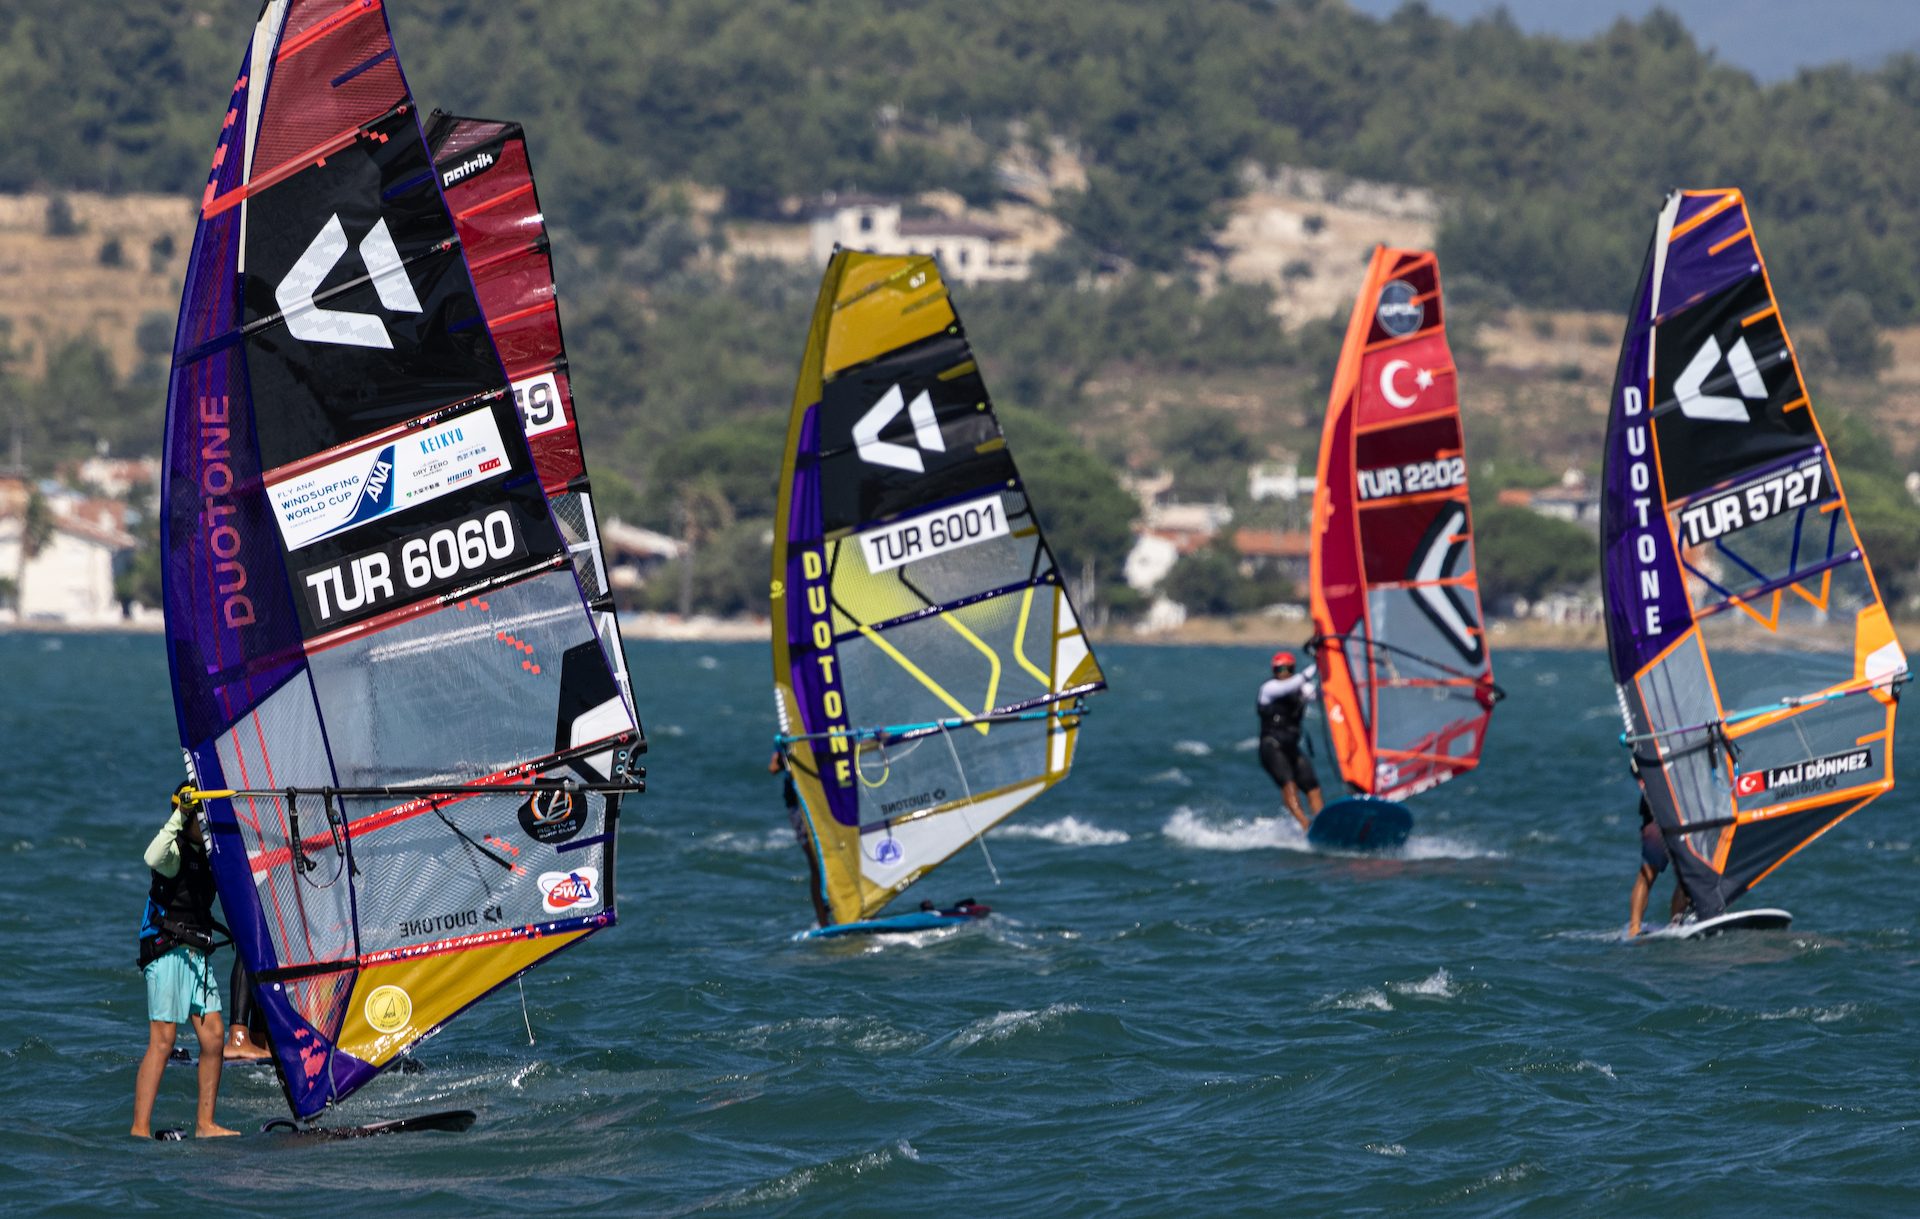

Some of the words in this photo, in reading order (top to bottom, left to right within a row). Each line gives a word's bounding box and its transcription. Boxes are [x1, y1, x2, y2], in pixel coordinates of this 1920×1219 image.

[443, 153, 494, 187] patrik
[420, 427, 464, 455] KEIKYU
[365, 460, 393, 503] ANA
[412, 467, 427, 477] DRY
[429, 460, 449, 471] ZERO
[1357, 466, 1403, 500] TUR
[1403, 457, 1467, 491] 2202
[277, 488, 294, 499] FLY
[296, 480, 316, 493] ANA!
[281, 475, 360, 510] WINDSURFING
[285, 501, 326, 522] WORLD
[328, 491, 352, 506] CUP
[1681, 494, 1744, 545] TUR
[1746, 464, 1823, 522] 5727
[200, 395, 256, 628] DUOTONE
[1624, 386, 1662, 635] DUOTONE
[870, 525, 923, 565] TUR
[929, 504, 996, 547] 6001
[306, 551, 395, 620] TUR
[402, 509, 515, 589] 6060
[803, 551, 853, 788] DUOTONE
[1805, 752, 1868, 780] DÖNMEZ
[553, 884, 587, 900] PWA
